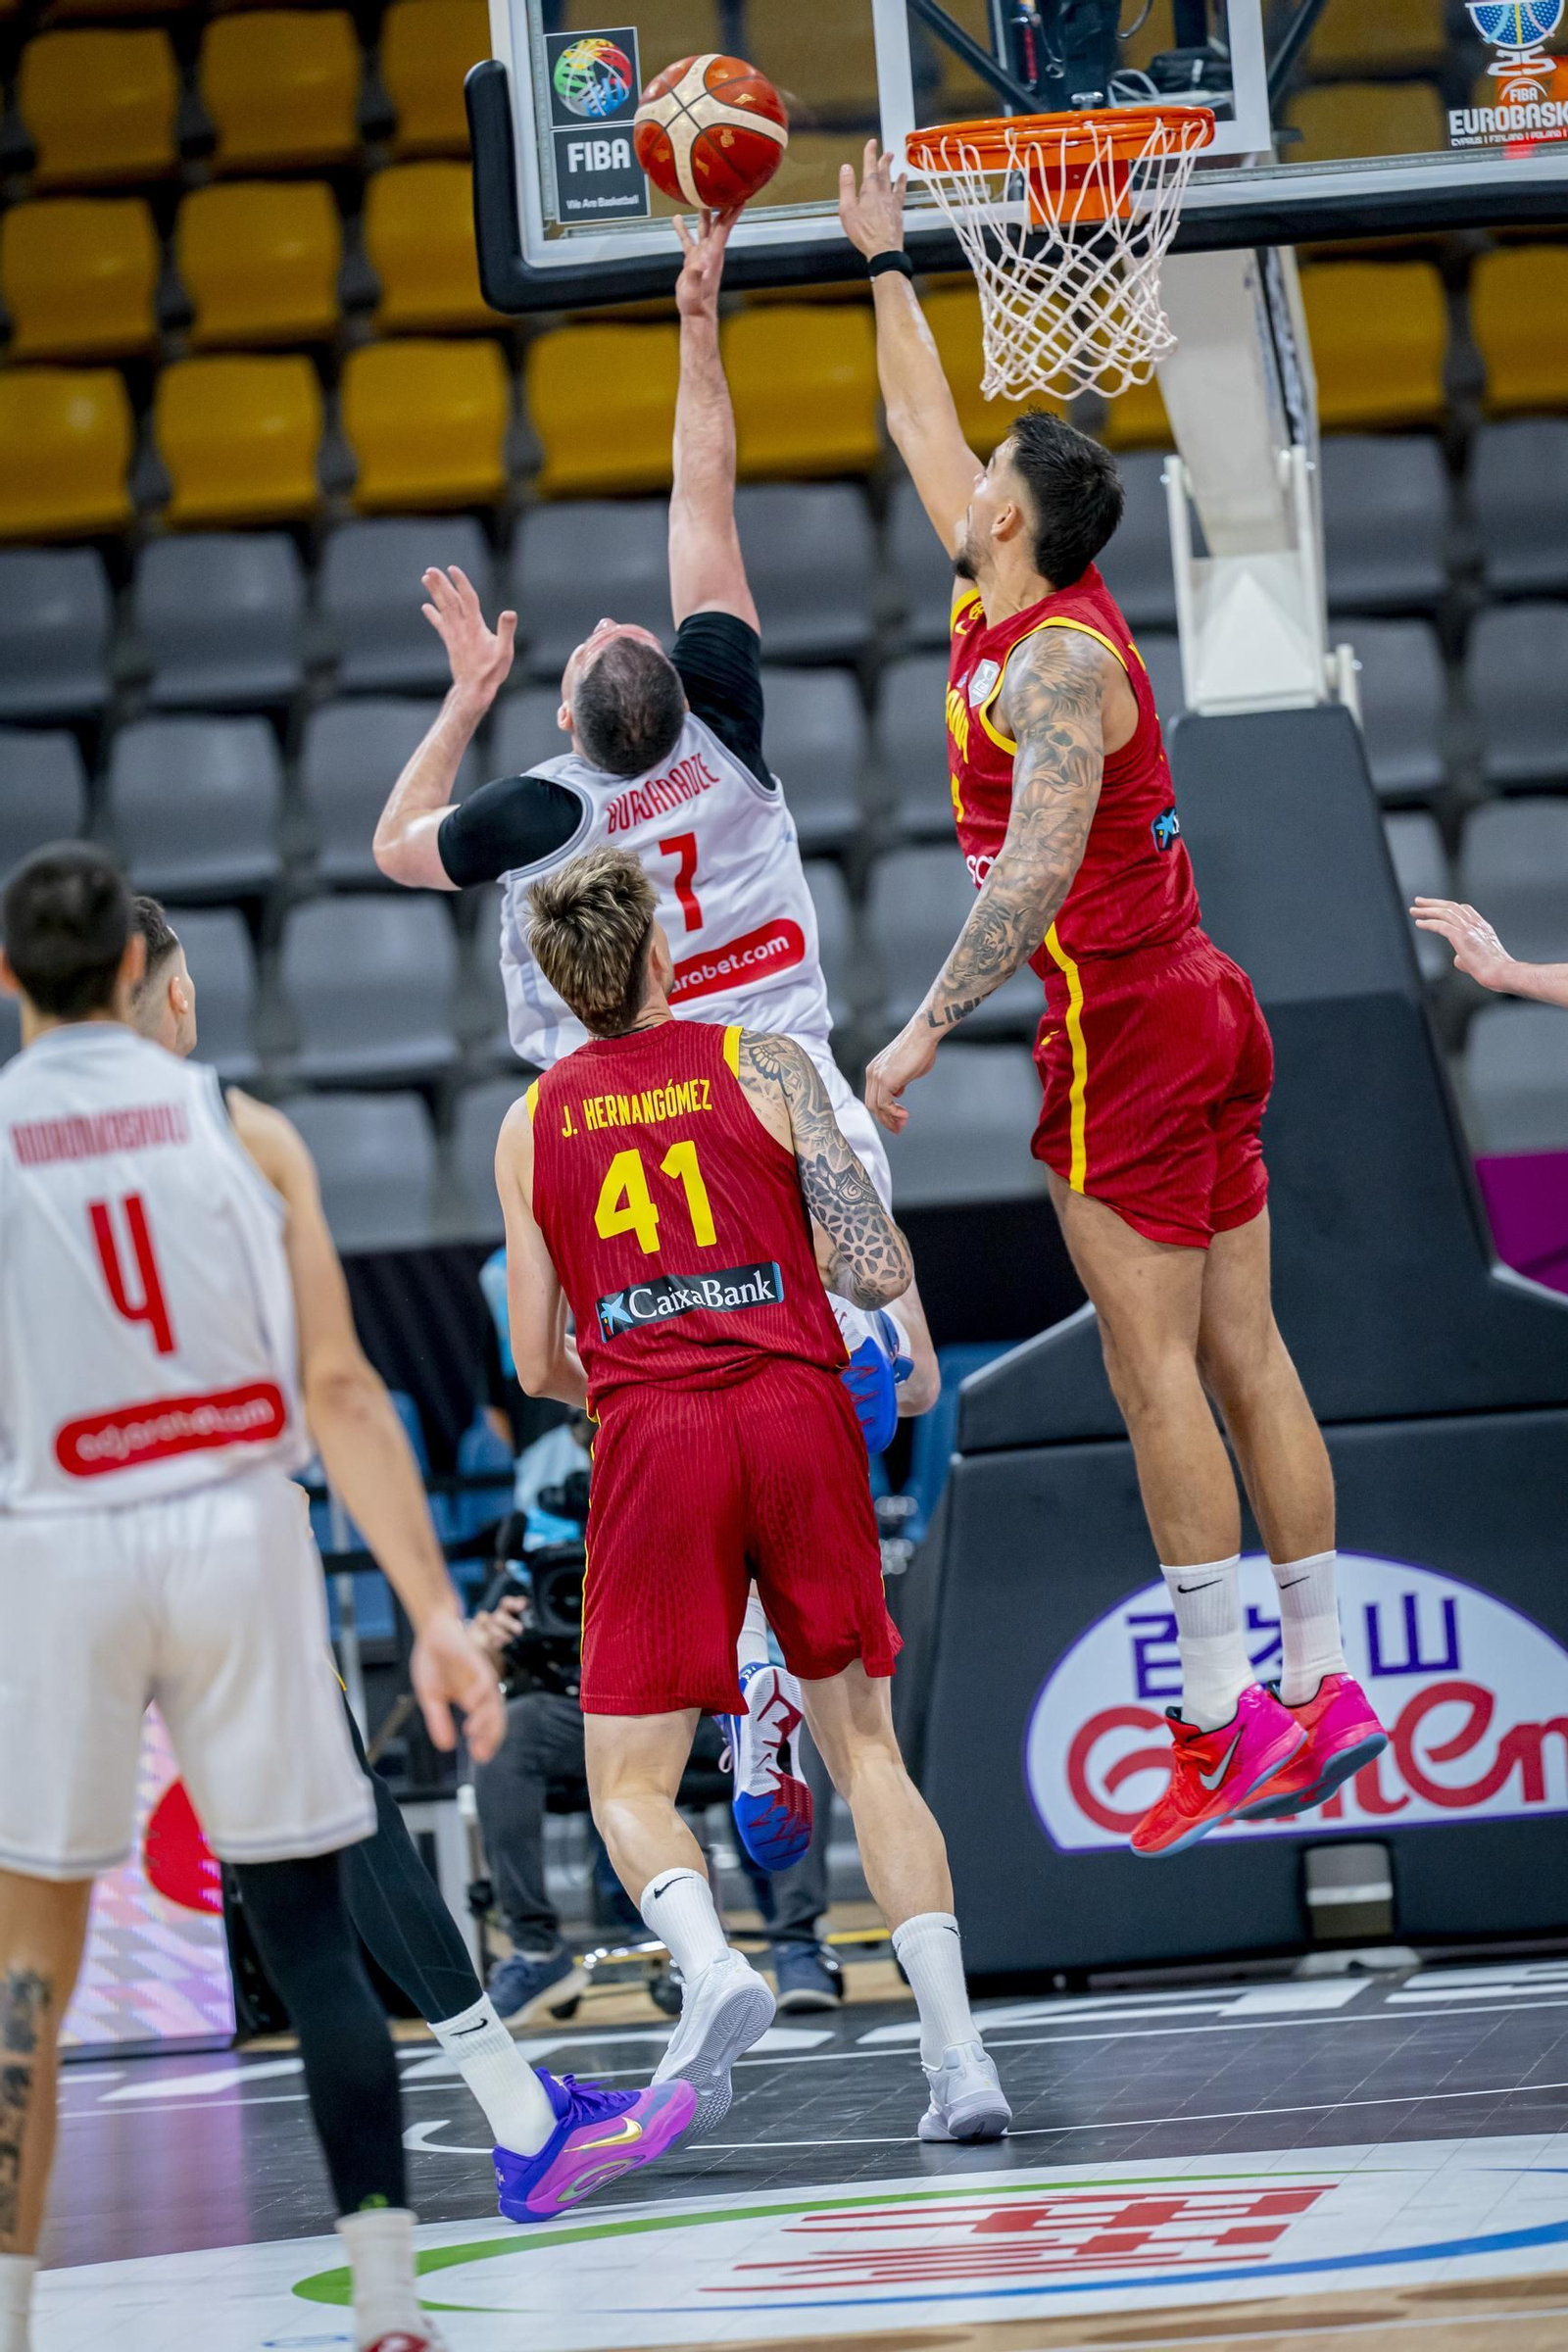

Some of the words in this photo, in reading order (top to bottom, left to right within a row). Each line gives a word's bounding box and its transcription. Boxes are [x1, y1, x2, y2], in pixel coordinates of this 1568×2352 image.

[1509, 87, 1539, 103] FIBA
[567, 138, 631, 173] FIBA
[659, 831, 704, 933] 7
[562, 1105, 578, 1139] J.
[582, 1078, 712, 1131] HERNANGÓMEZ
[594, 1140, 717, 1254] 41
[88, 1191, 176, 1355] 4
[628, 1270, 775, 1319] CaixaBank
